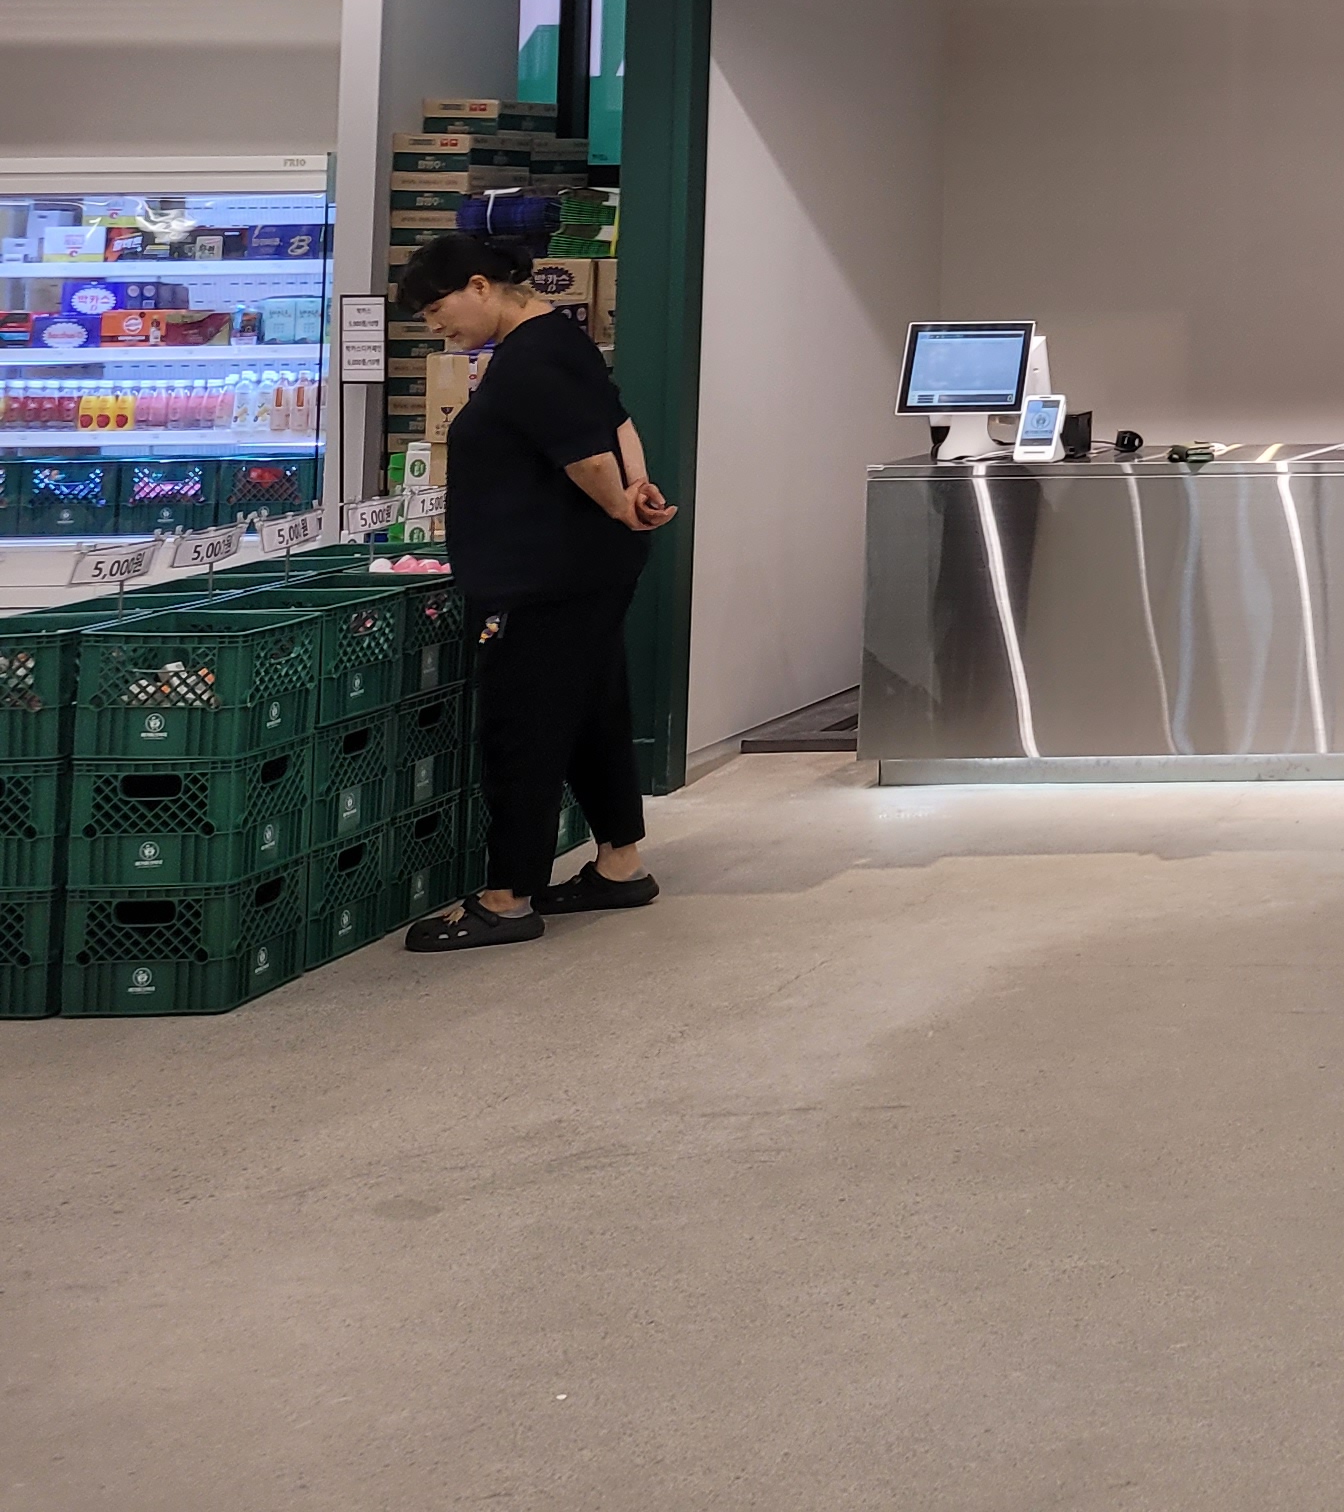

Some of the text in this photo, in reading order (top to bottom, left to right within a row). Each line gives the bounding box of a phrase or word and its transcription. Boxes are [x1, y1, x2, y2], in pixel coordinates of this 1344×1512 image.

[283, 158, 306, 167] FRIO
[534, 273, 571, 286] 박카스
[77, 294, 111, 304] 박카스
[92, 551, 146, 579] 5,000원
